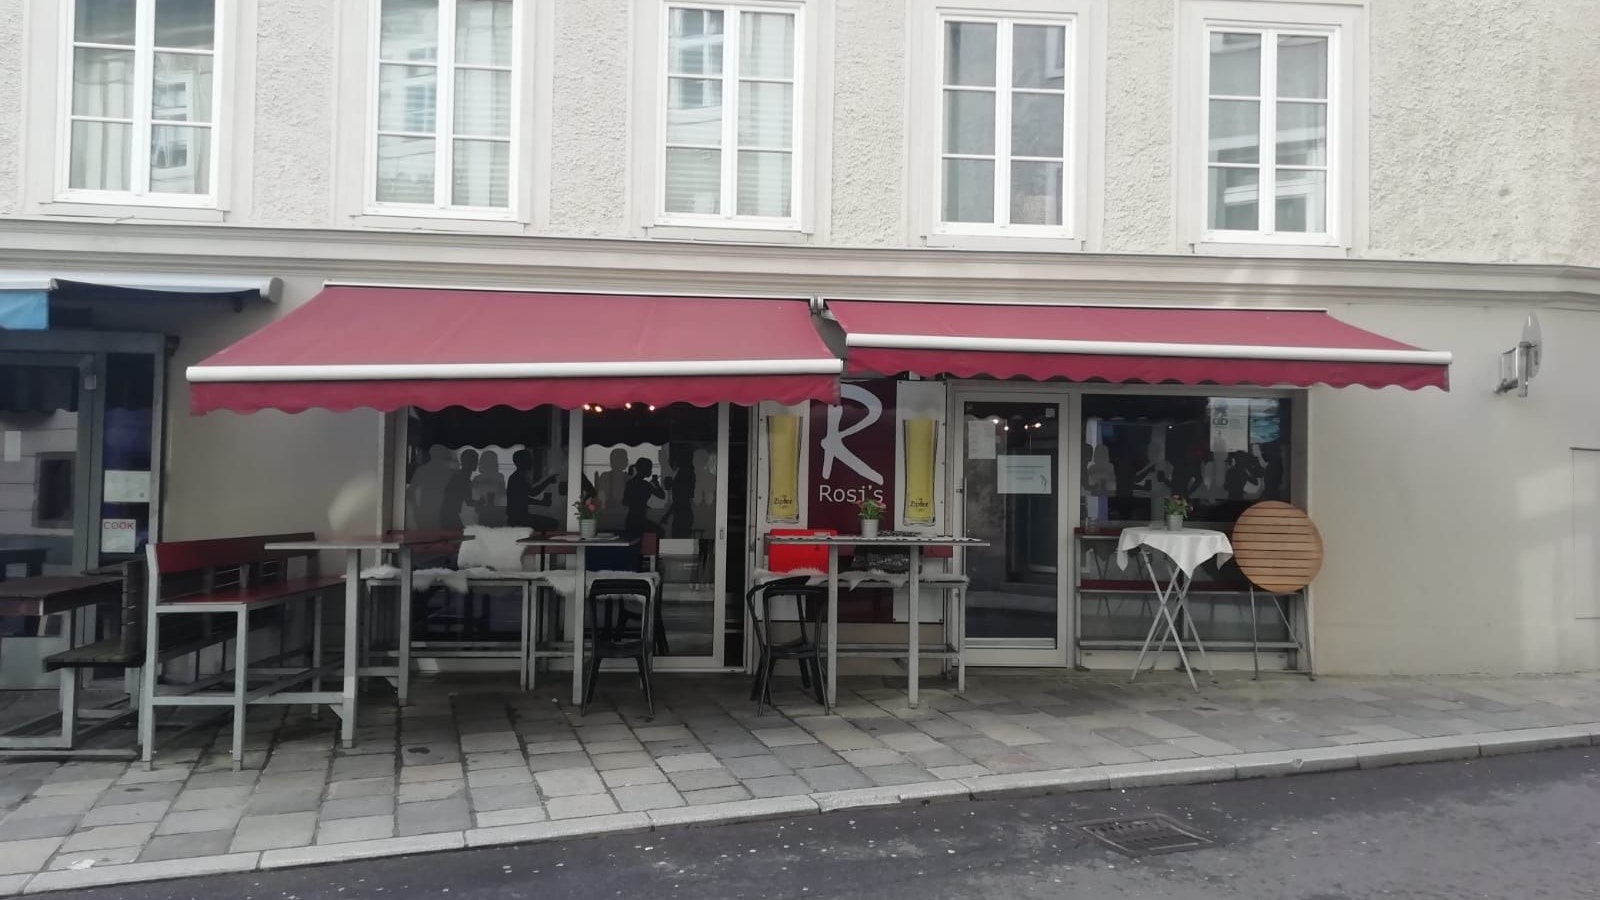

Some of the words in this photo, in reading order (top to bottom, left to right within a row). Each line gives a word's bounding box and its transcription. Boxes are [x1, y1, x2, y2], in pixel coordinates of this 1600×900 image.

[820, 383, 884, 486] R
[818, 484, 884, 503] Rosi's
[104, 521, 134, 530] COOK
